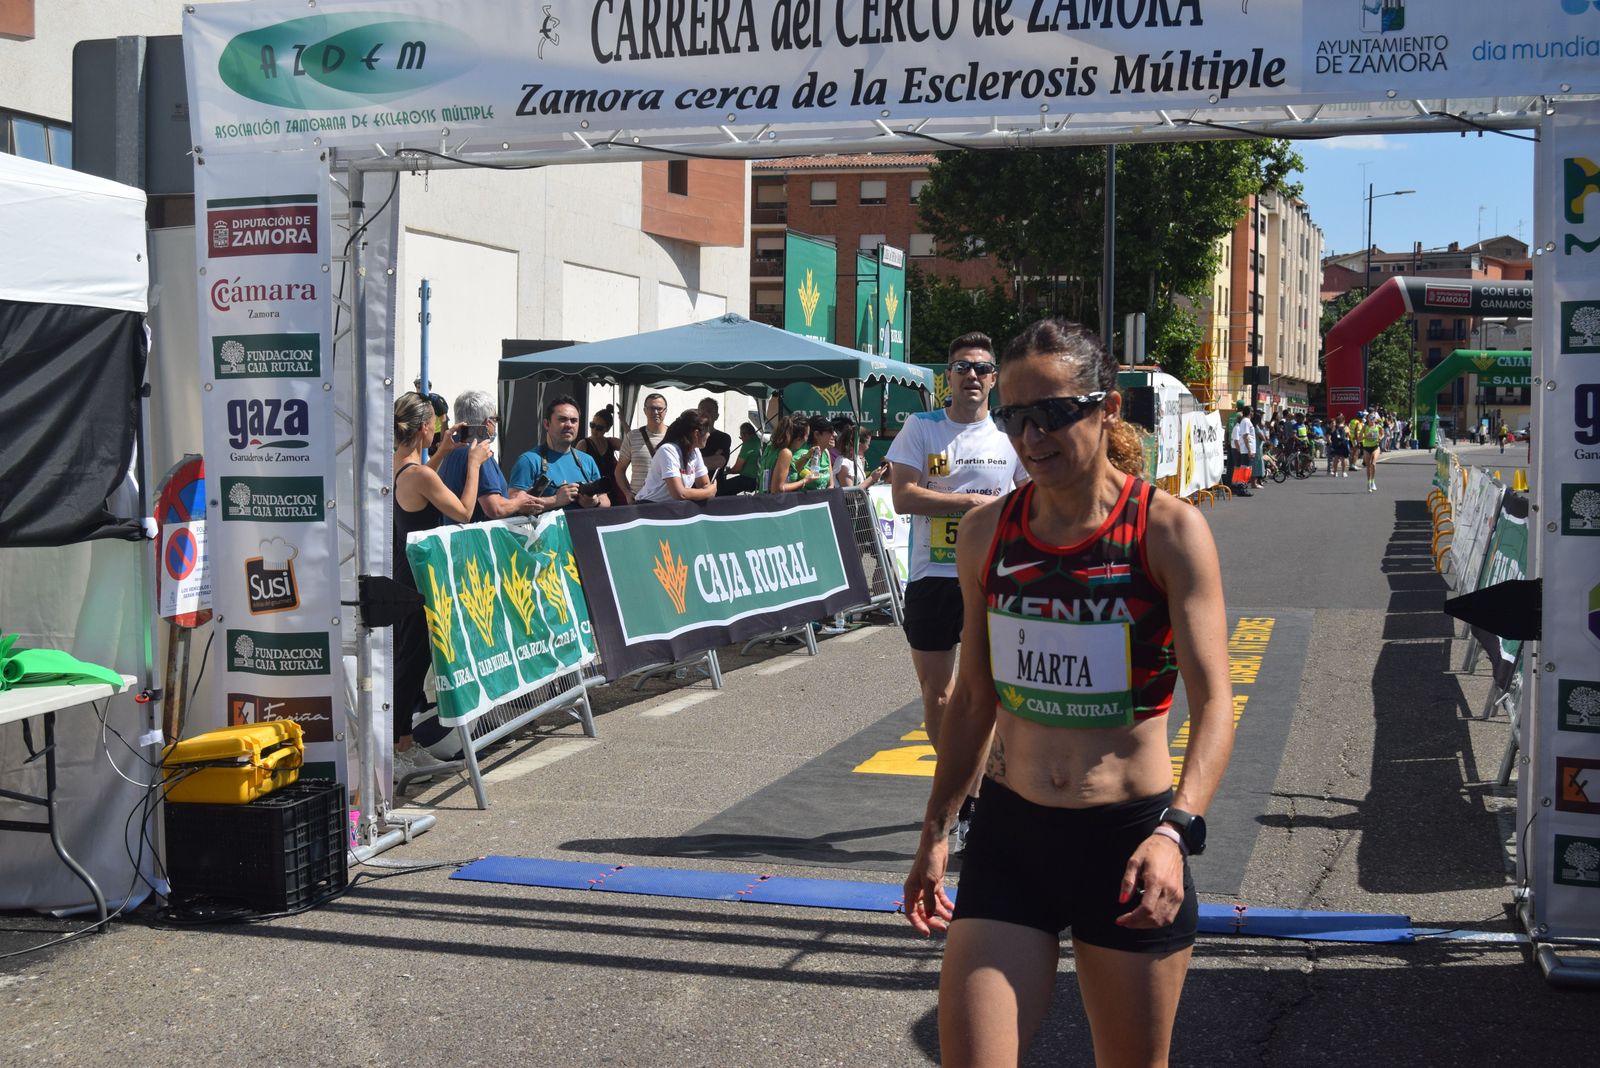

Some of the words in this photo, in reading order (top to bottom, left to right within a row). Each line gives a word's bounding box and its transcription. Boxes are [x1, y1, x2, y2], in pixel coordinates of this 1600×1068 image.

[591, 0, 760, 63] CARRERA
[771, 0, 822, 51] del
[836, 0, 959, 47] CERCO
[973, 0, 1014, 38] de
[1316, 35, 1449, 55] AYUNTAMIENTO
[1472, 40, 1506, 61] dia
[1316, 55, 1342, 74] DE
[1349, 52, 1448, 74] ZAMORA
[515, 83, 664, 117] Zamora
[675, 82, 778, 110] cerca
[792, 71, 837, 110] de
[850, 69, 888, 107] la
[899, 56, 1098, 104] Esclerosis
[1110, 48, 1286, 99] Múltiple
[215, 119, 280, 139] ASOCIACIÓN
[286, 116, 347, 134] ZAMORANA
[352, 114, 368, 129] DE
[374, 109, 437, 127] ESCLEROSIS
[441, 105, 495, 122] MÚLTIPLE
[232, 216, 293, 229] DIPUTACIÓN
[295, 216, 311, 226] DE
[231, 228, 312, 247] ZAMORA
[1481, 286, 1504, 297] CON
[1507, 287, 1521, 297] EL
[248, 309, 280, 319] Zamora
[1480, 299, 1533, 310] GANAMOS
[246, 350, 313, 361] FUNDACION
[247, 362, 268, 373] CAJA
[271, 361, 313, 373] RURAL
[226, 399, 309, 450] gaza
[230, 452, 263, 462] Ganaderos
[264, 453, 273, 462] de
[275, 453, 310, 462] Zamora
[252, 494, 318, 505] FUNDACION
[252, 506, 272, 517] CAJA
[275, 506, 318, 517] RURAL
[693, 549, 753, 604] CAJA
[745, 541, 818, 595] RURAL
[250, 571, 291, 601] Susi
[997, 593, 1136, 625] KENYA
[1018, 628, 1025, 645] 9
[255, 647, 323, 660] FUNDACION
[255, 659, 276, 671] CAJA
[280, 659, 323, 671] RURAL
[1017, 649, 1093, 688] MARTA
[1026, 697, 1063, 716] CAJA
[1067, 701, 1124, 718] RURAL
